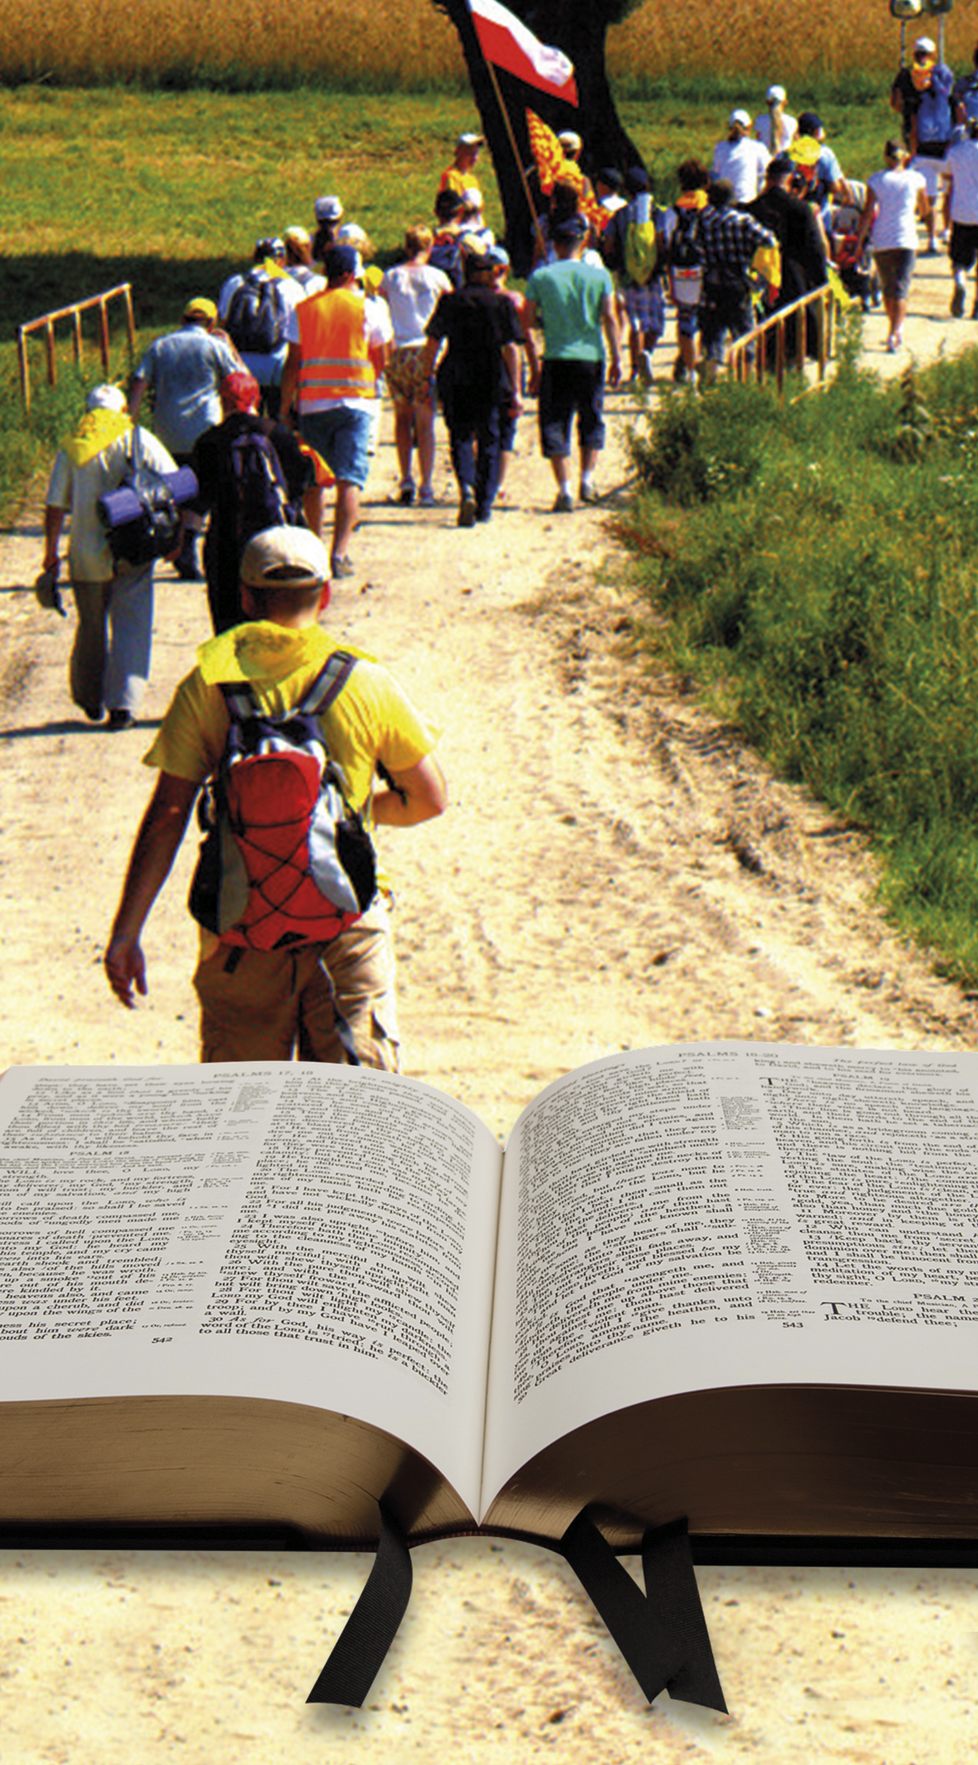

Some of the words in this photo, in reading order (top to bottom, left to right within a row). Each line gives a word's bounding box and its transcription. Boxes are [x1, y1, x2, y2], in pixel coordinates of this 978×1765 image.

[913, 1293, 966, 1302] PSALM
[924, 1319, 957, 1327] thee;
[275, 1331, 300, 1339] that
[305, 1335, 334, 1345] trust
[354, 1346, 378, 1359] him.
